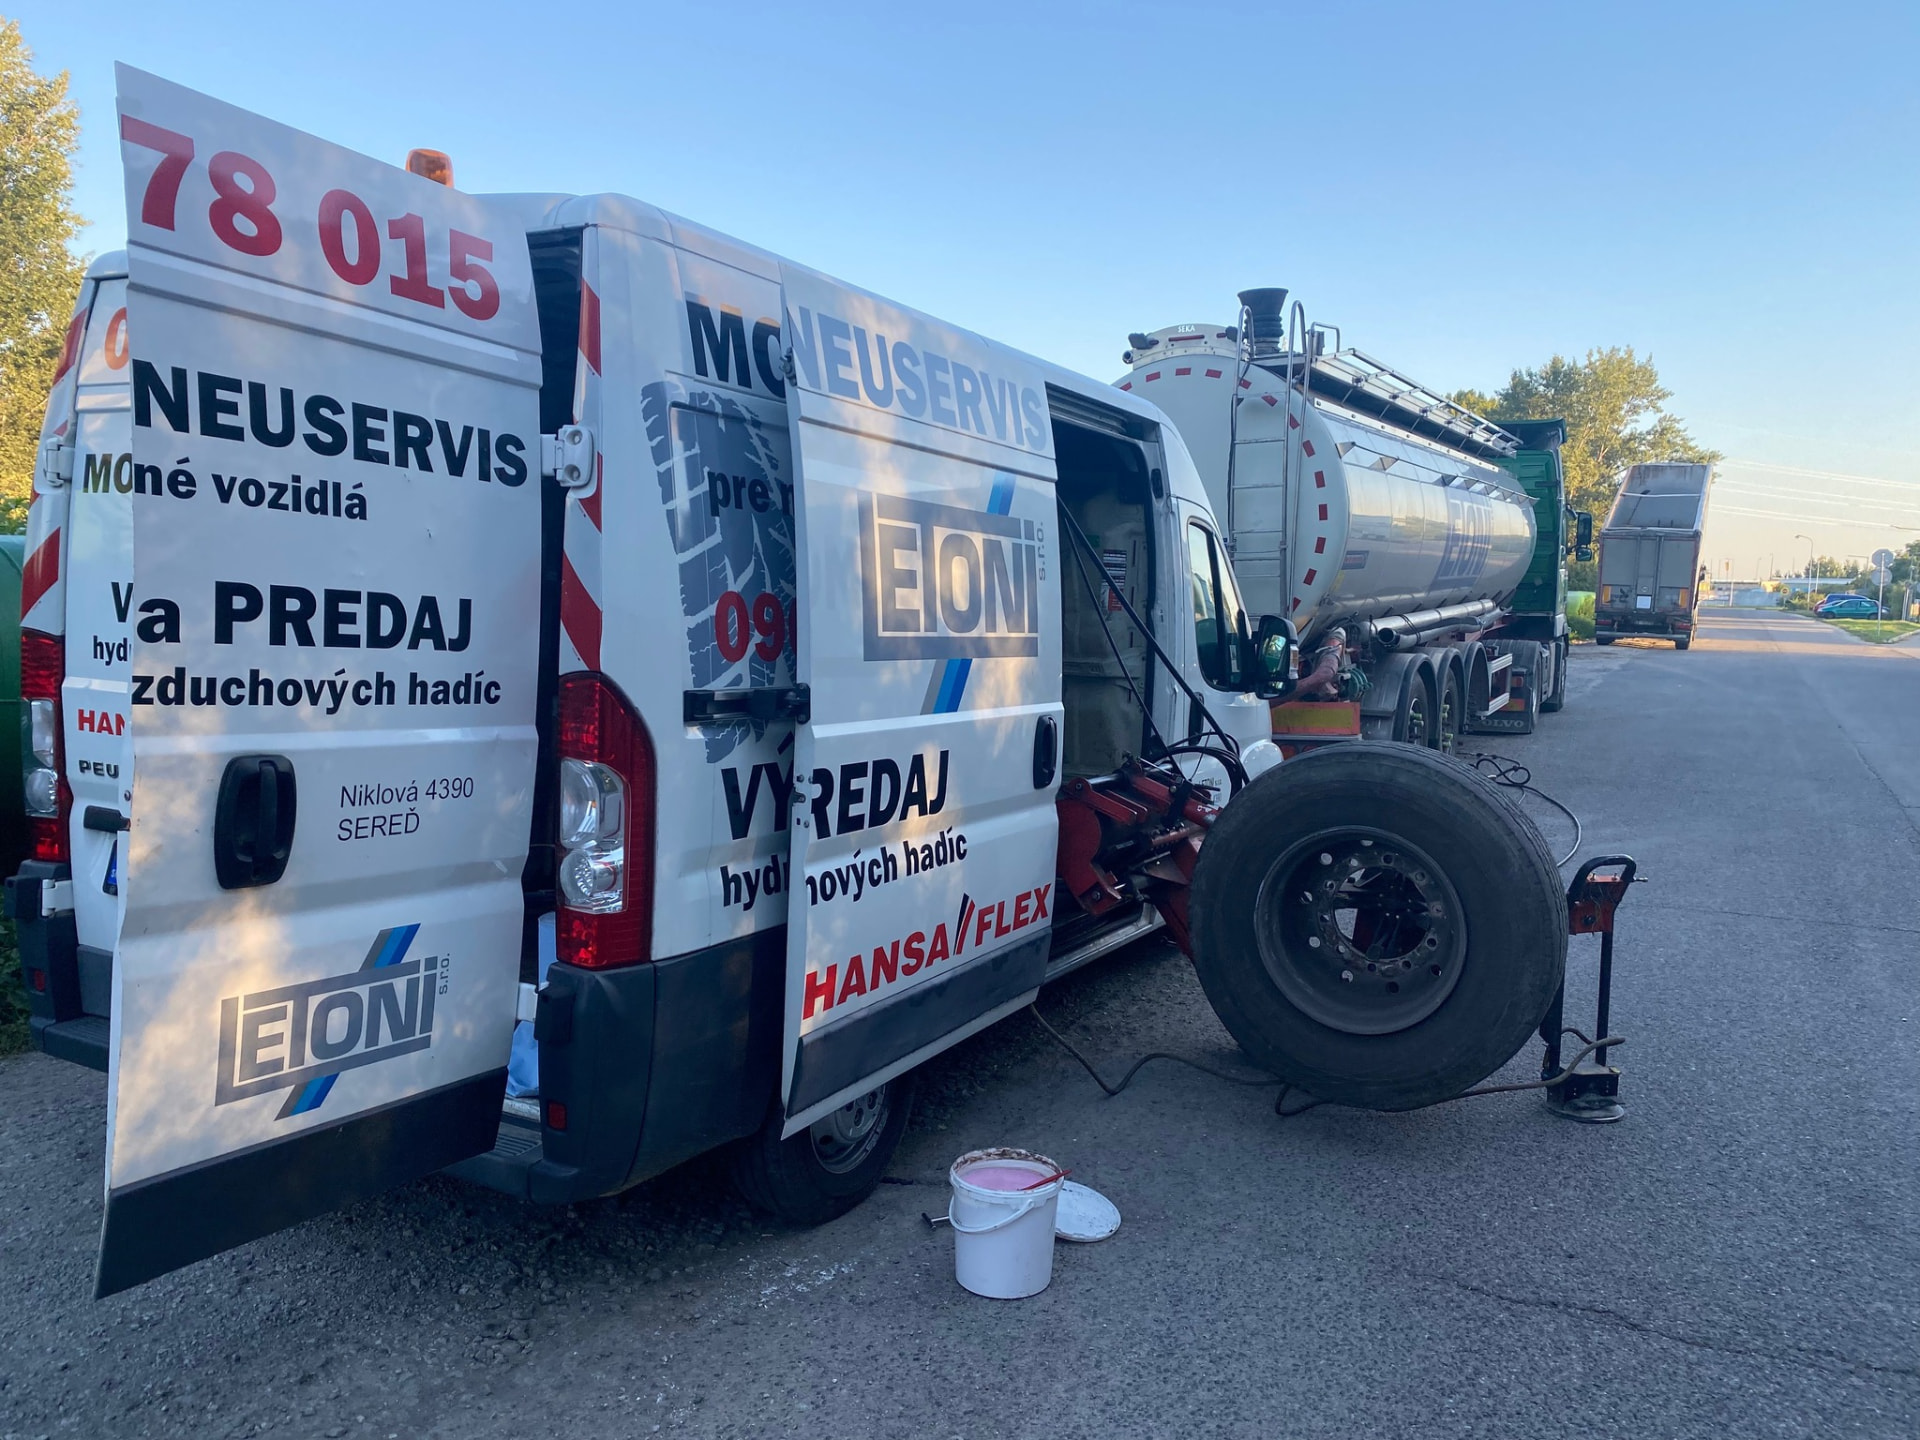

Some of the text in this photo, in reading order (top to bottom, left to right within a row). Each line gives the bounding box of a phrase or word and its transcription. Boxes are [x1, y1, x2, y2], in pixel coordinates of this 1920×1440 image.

[121, 114, 501, 321] 78 015
[1177, 325, 1195, 333] SEKA
[786, 305, 1047, 452] NEUSERVIS
[132, 358, 528, 488] NEUSERVIS
[133, 457, 368, 521] né vozidlá
[708, 471, 771, 518] pre
[136, 581, 472, 652] a PREDAJ
[93, 635, 131, 666] hyd
[132, 667, 501, 715] zduchových hadíc
[1480, 720, 1524, 728] OLVO
[79, 760, 119, 779] PEU
[340, 777, 474, 808] Niklová 4390
[811, 749, 950, 840] REDAJ
[337, 807, 420, 842] SEREĎ
[903, 826, 968, 878] hadíc
[438, 952, 451, 996] s.r.o.
